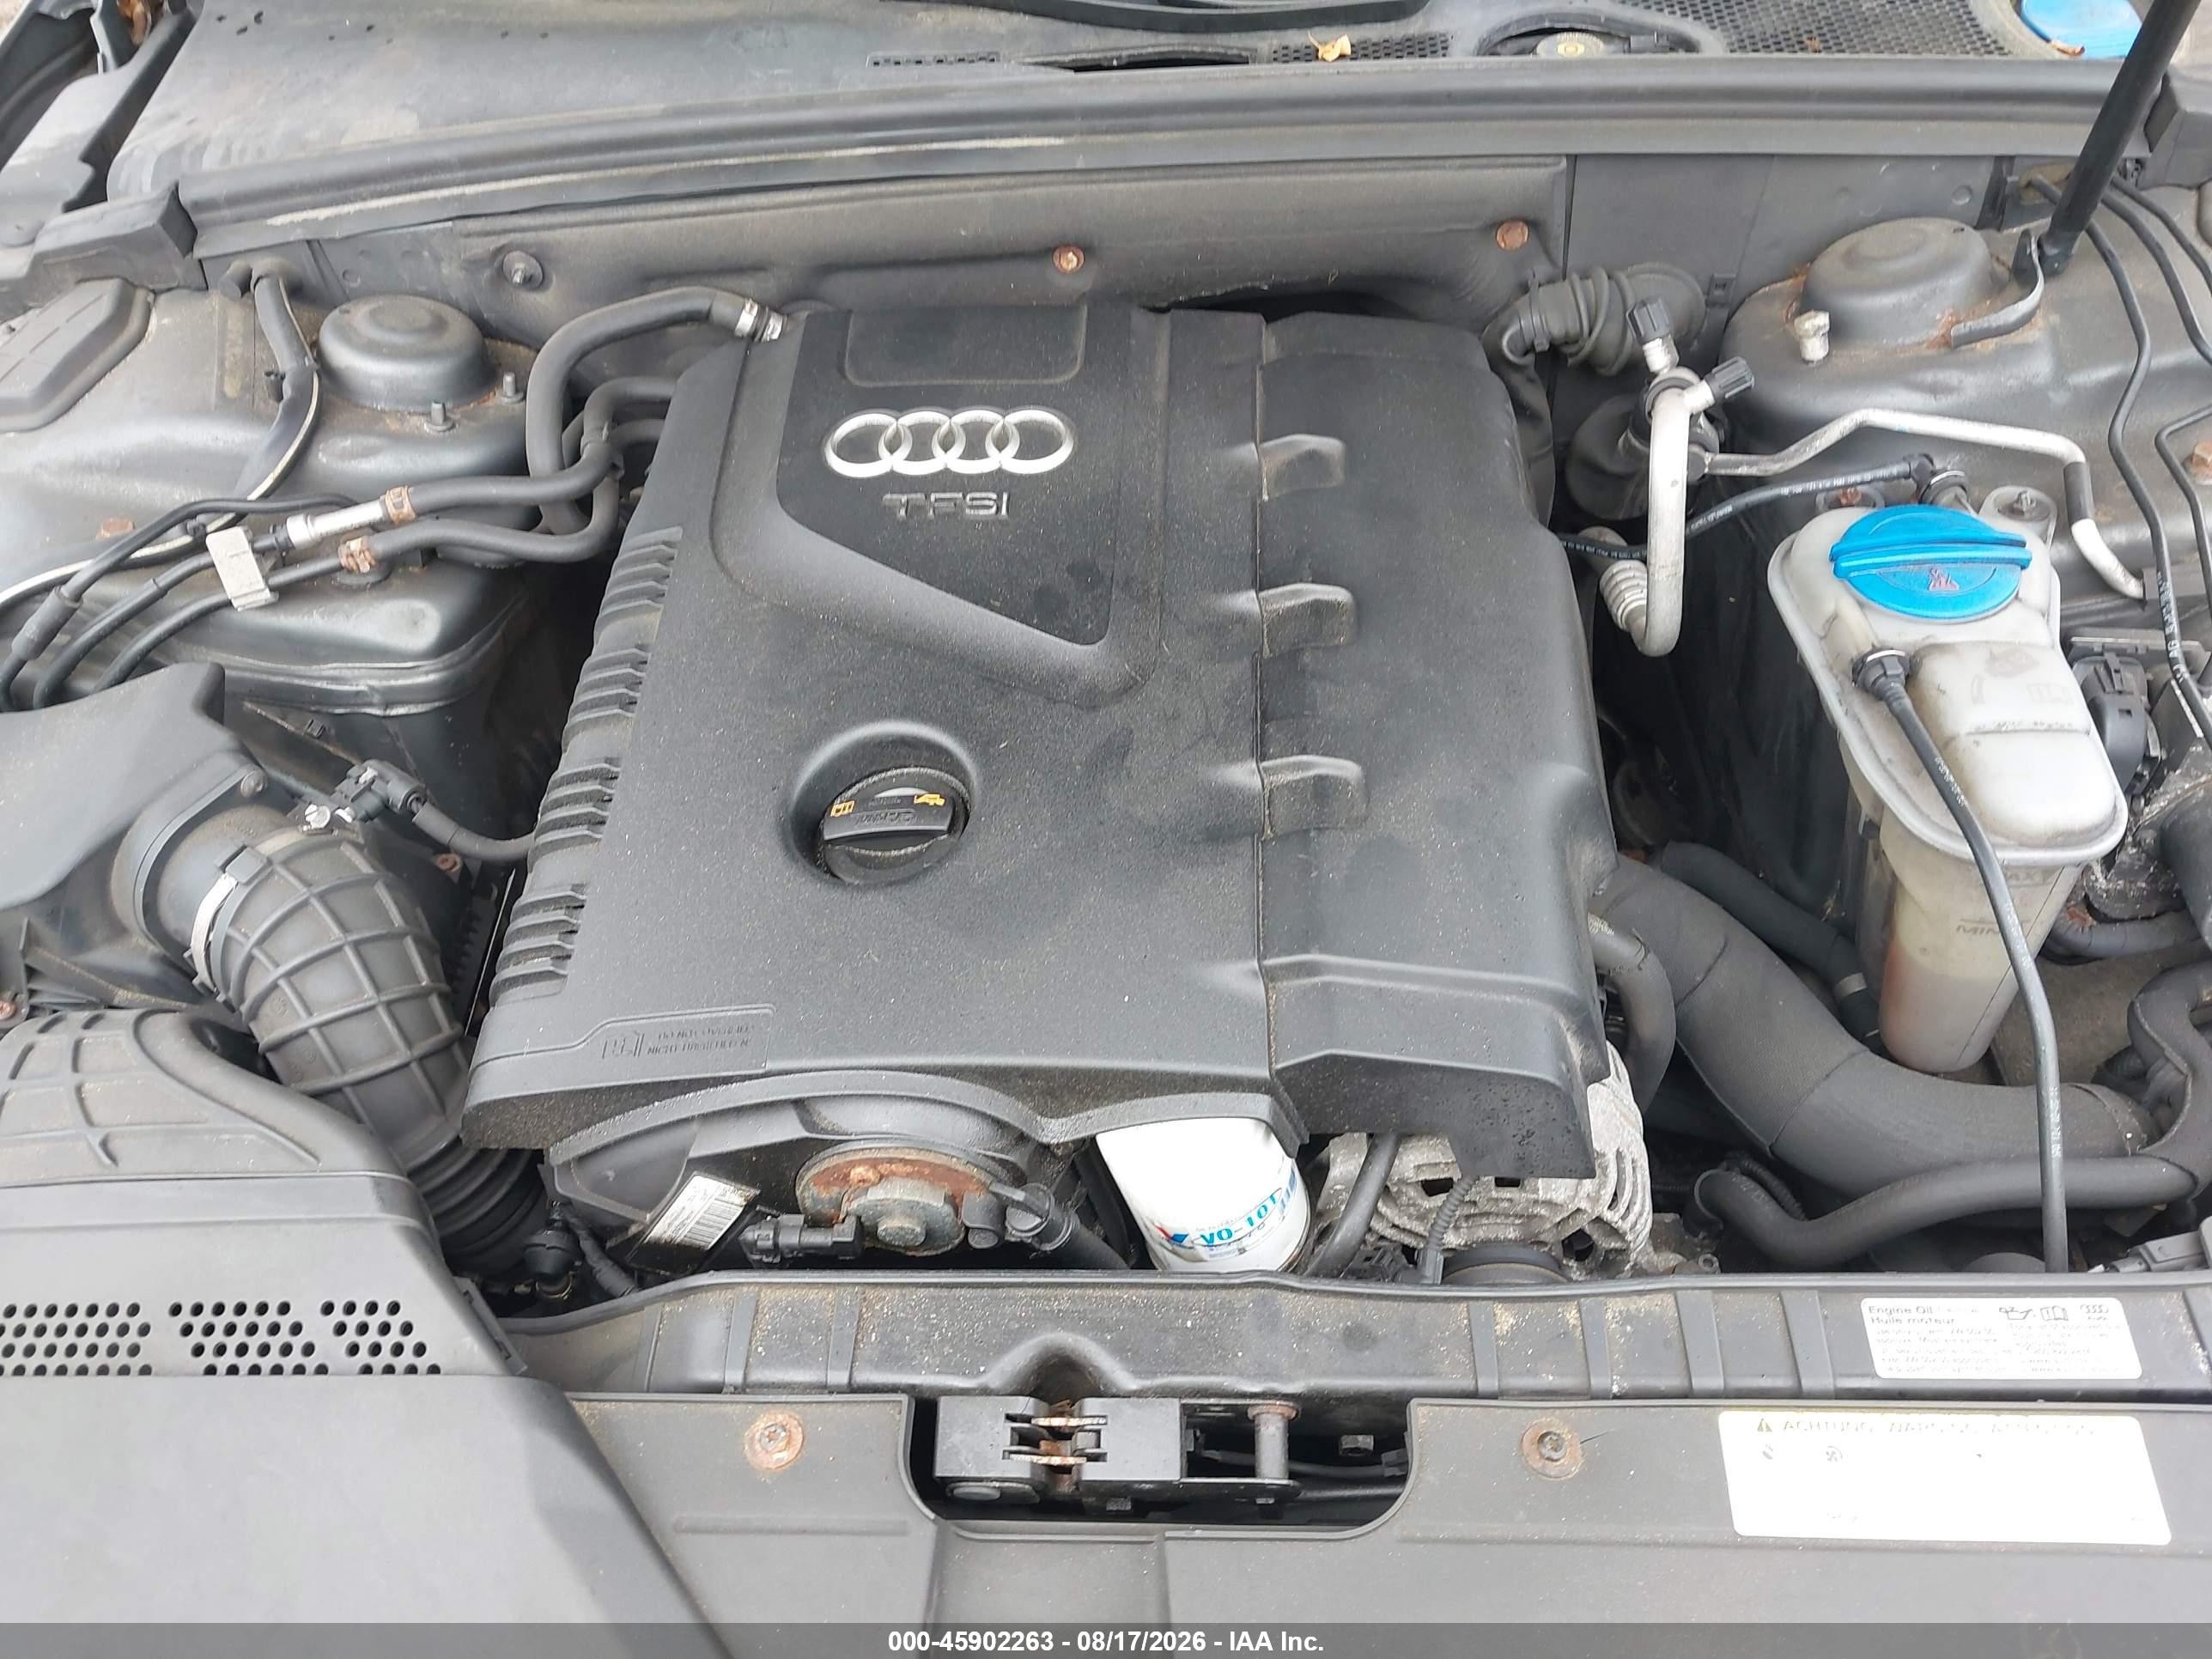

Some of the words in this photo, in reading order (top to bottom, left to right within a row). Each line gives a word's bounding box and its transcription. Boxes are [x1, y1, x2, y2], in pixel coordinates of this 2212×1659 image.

[882, 491, 1009, 518] TFSI
[1869, 1306, 1912, 1316] Engine
[1916, 1304, 1934, 1315] Oil
